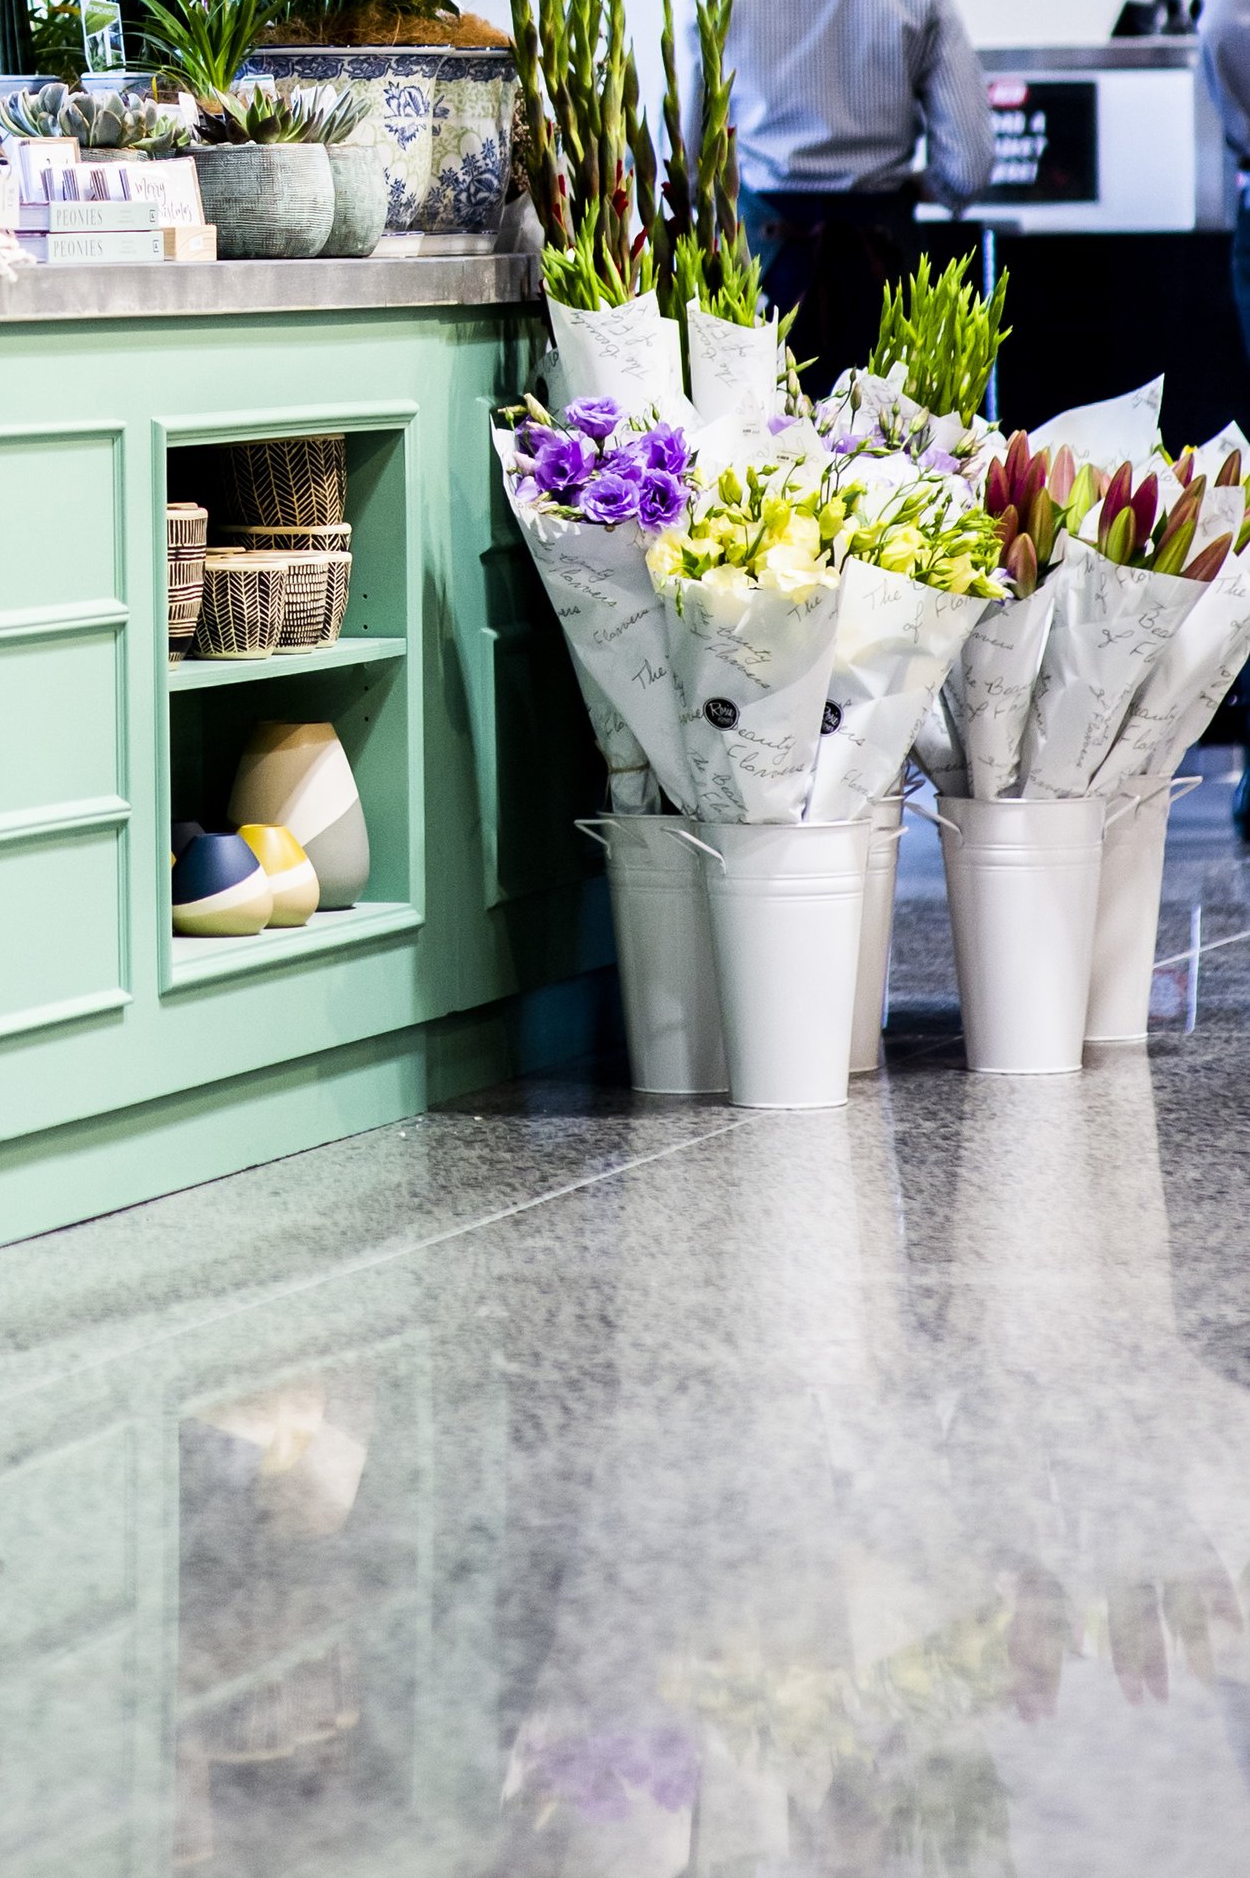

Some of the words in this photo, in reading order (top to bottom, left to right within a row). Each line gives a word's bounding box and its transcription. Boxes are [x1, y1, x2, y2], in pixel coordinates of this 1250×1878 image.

[134, 177, 167, 207] Merry
[56, 208, 103, 226] PEONIES
[160, 202, 192, 223] istmas
[53, 239, 103, 257] PEONIES
[786, 595, 824, 623] The
[862, 578, 903, 611] The
[902, 600, 925, 644] of
[716, 625, 773, 665] Beauty
[631, 659, 668, 690] The
[704, 643, 771, 689] Flowers
[730, 724, 797, 766] eauty
[726, 744, 805, 779] Flowers
